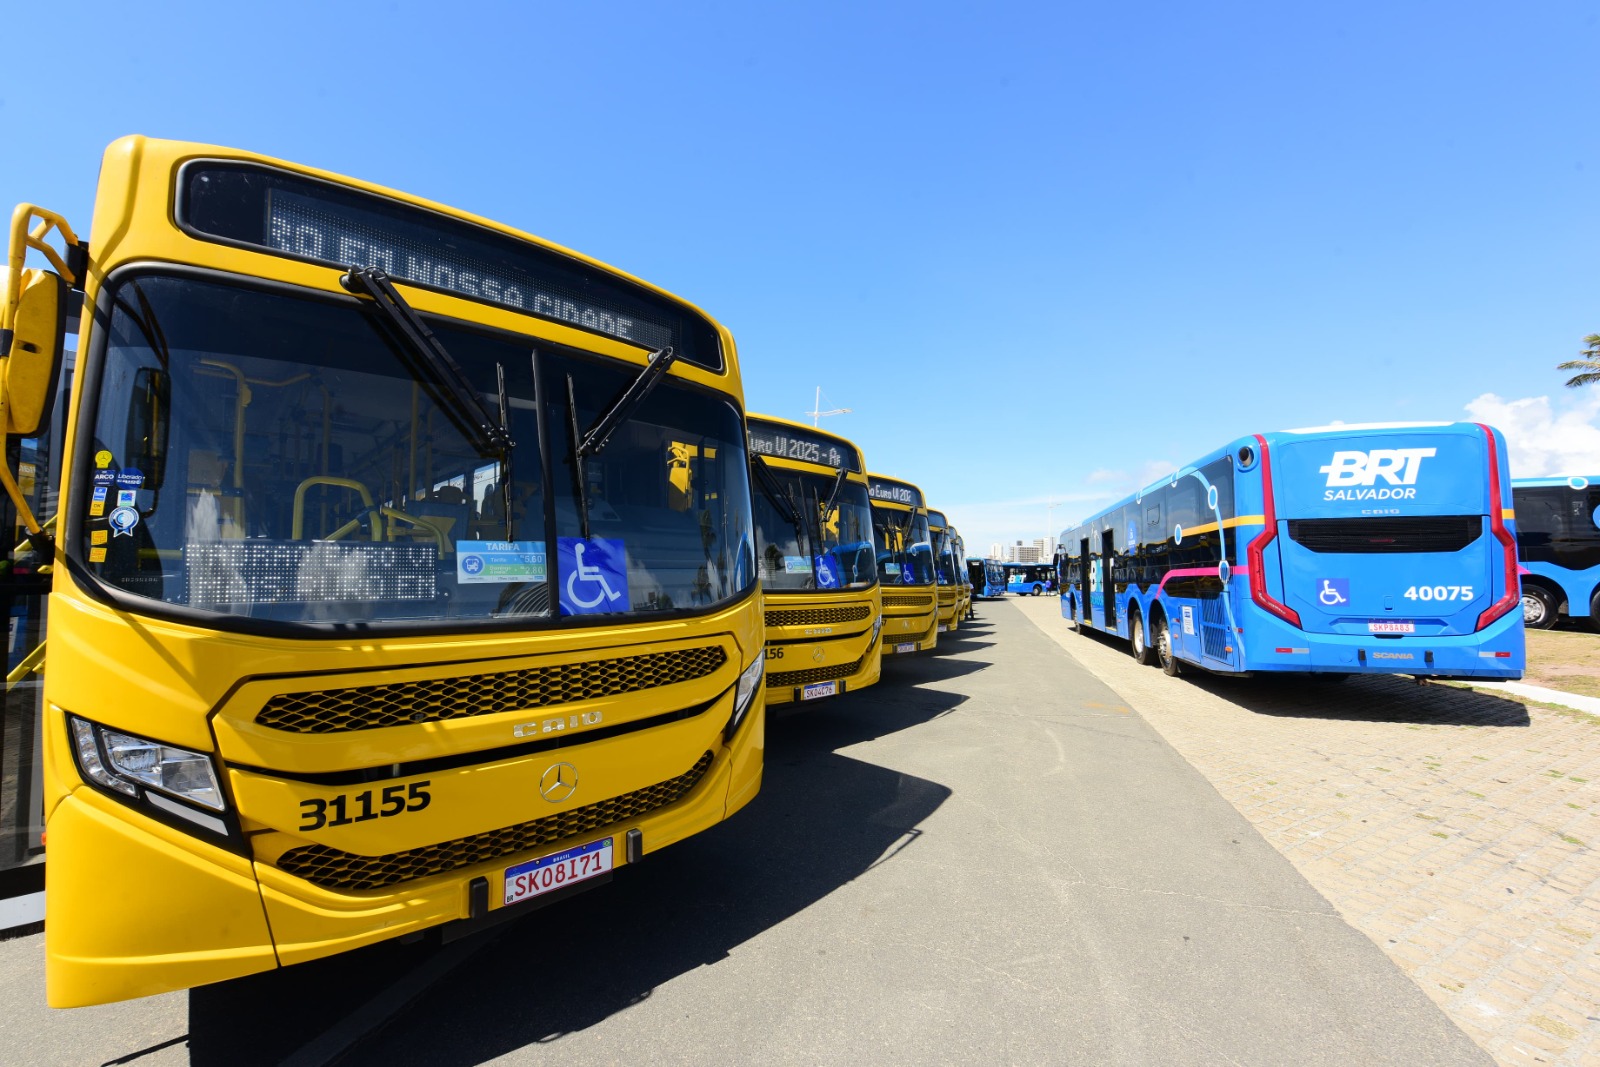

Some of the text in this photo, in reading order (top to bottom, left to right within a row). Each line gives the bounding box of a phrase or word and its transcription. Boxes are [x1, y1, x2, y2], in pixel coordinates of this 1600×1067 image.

[339, 236, 393, 275] EM
[407, 256, 523, 308] NOSSA
[534, 293, 633, 340] CIDADE
[775, 435, 787, 457] VI
[788, 439, 820, 462] 2025
[1319, 447, 1437, 487] BRT
[1323, 487, 1417, 501] SALVADOR
[485, 542, 520, 551] TARIFA
[1403, 586, 1474, 601] 40075
[1372, 651, 1415, 660] SCANIA
[513, 711, 603, 738] CAIO
[299, 780, 432, 832] 31155
[553, 853, 571, 863] BRASIL
